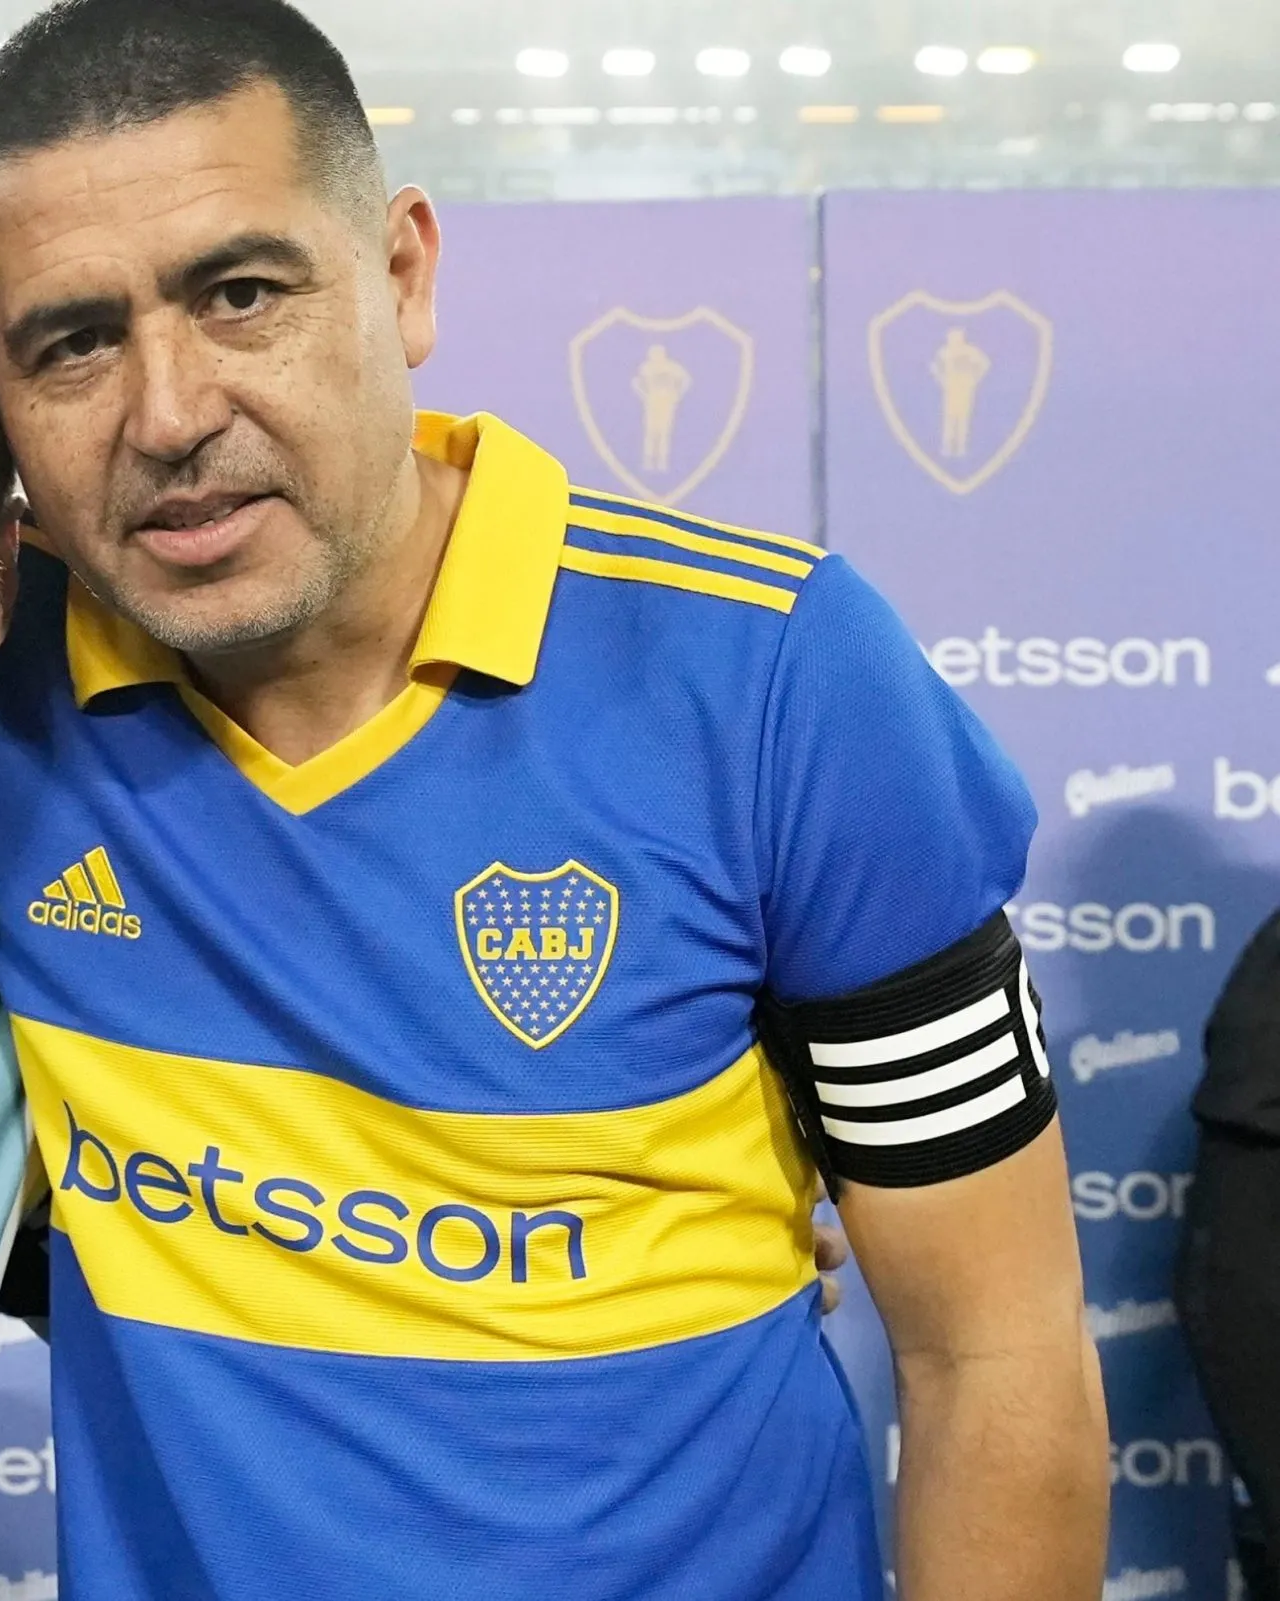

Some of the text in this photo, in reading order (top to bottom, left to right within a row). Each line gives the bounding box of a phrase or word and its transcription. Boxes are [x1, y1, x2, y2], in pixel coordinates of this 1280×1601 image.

[923, 626, 1210, 687] etsson
[1214, 755, 1280, 822] b
[28, 899, 141, 940] adidas
[476, 927, 595, 960] CABJ
[1004, 902, 1214, 951] sson
[59, 1099, 586, 1284] betsson
